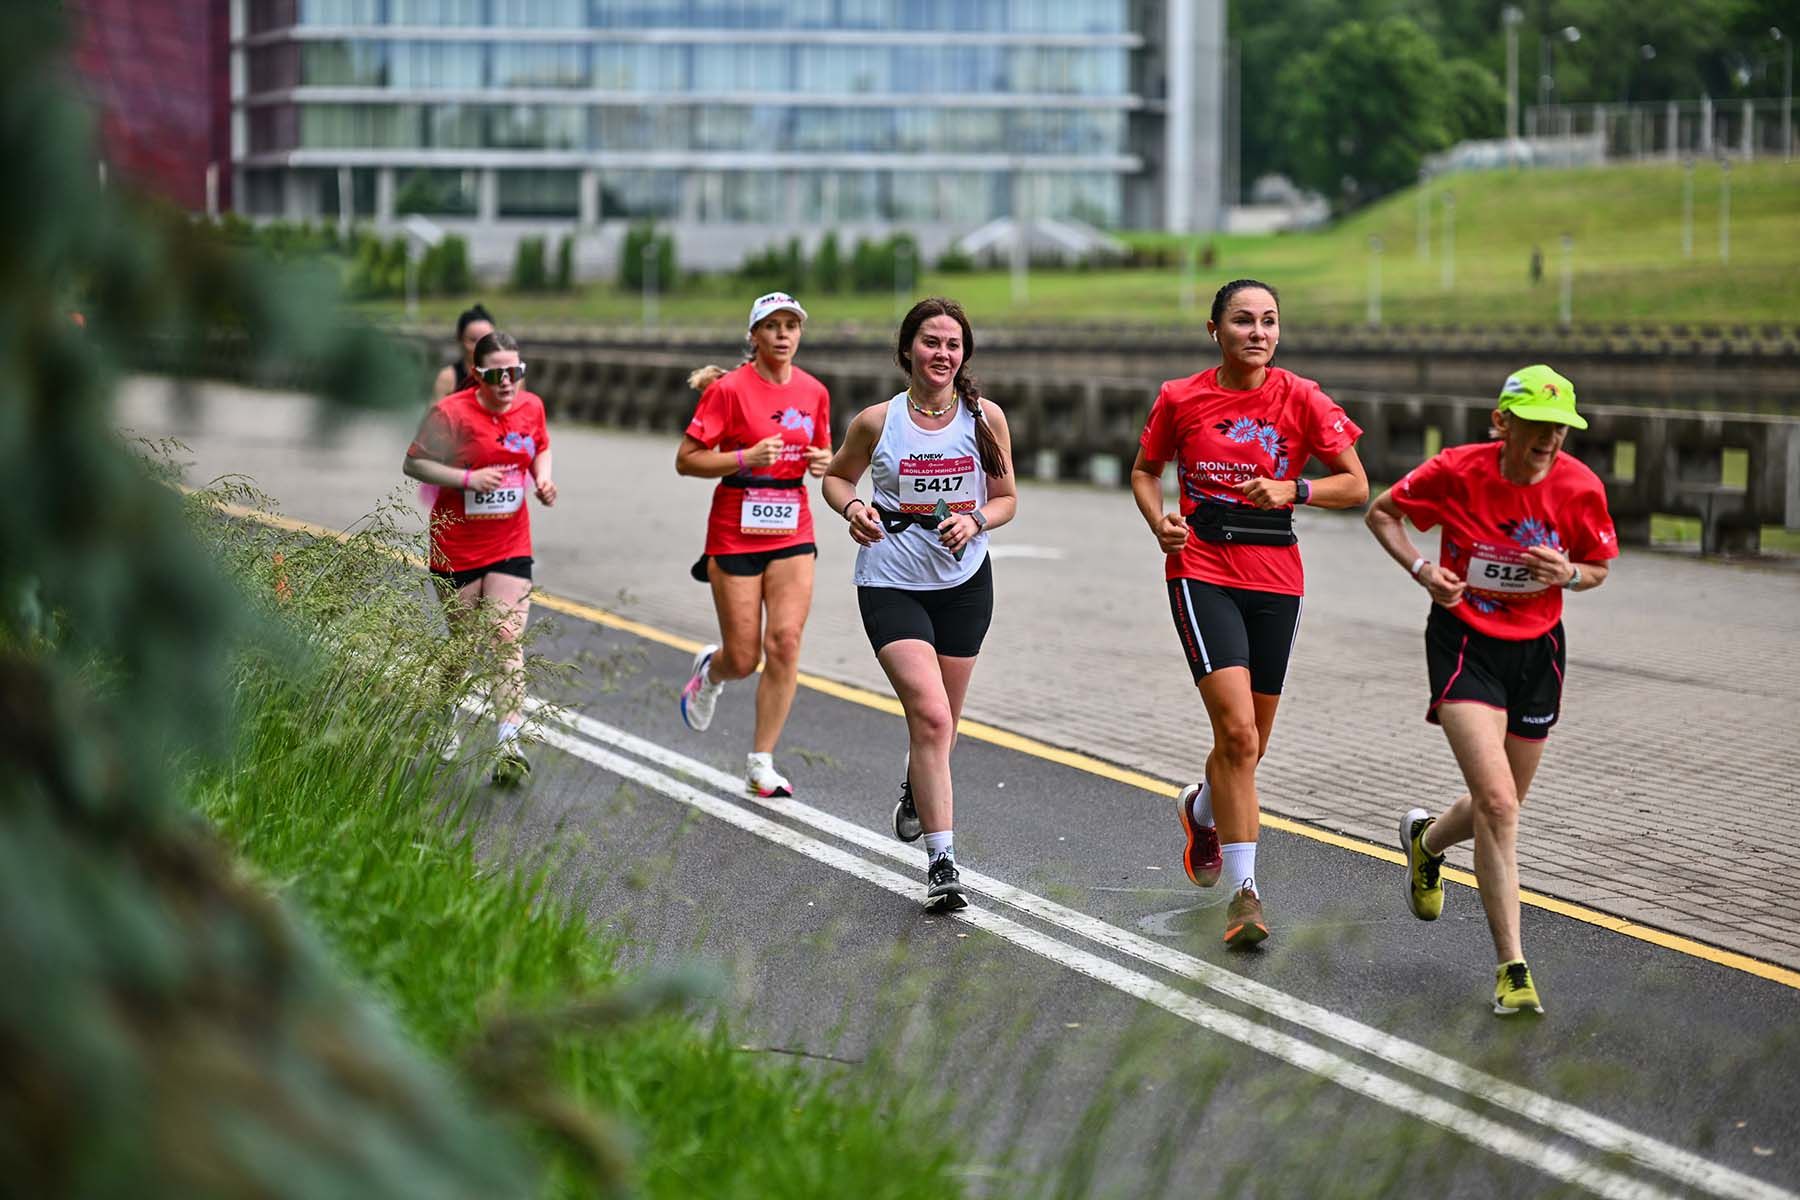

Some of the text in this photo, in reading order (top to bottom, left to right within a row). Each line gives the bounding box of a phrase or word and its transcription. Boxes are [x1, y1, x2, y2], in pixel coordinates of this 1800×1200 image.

[1196, 461, 1258, 473] IRONLADY
[914, 475, 963, 493] 5417
[474, 490, 516, 505] 5235
[752, 504, 793, 518] 5032
[1484, 563, 1535, 581] 512
